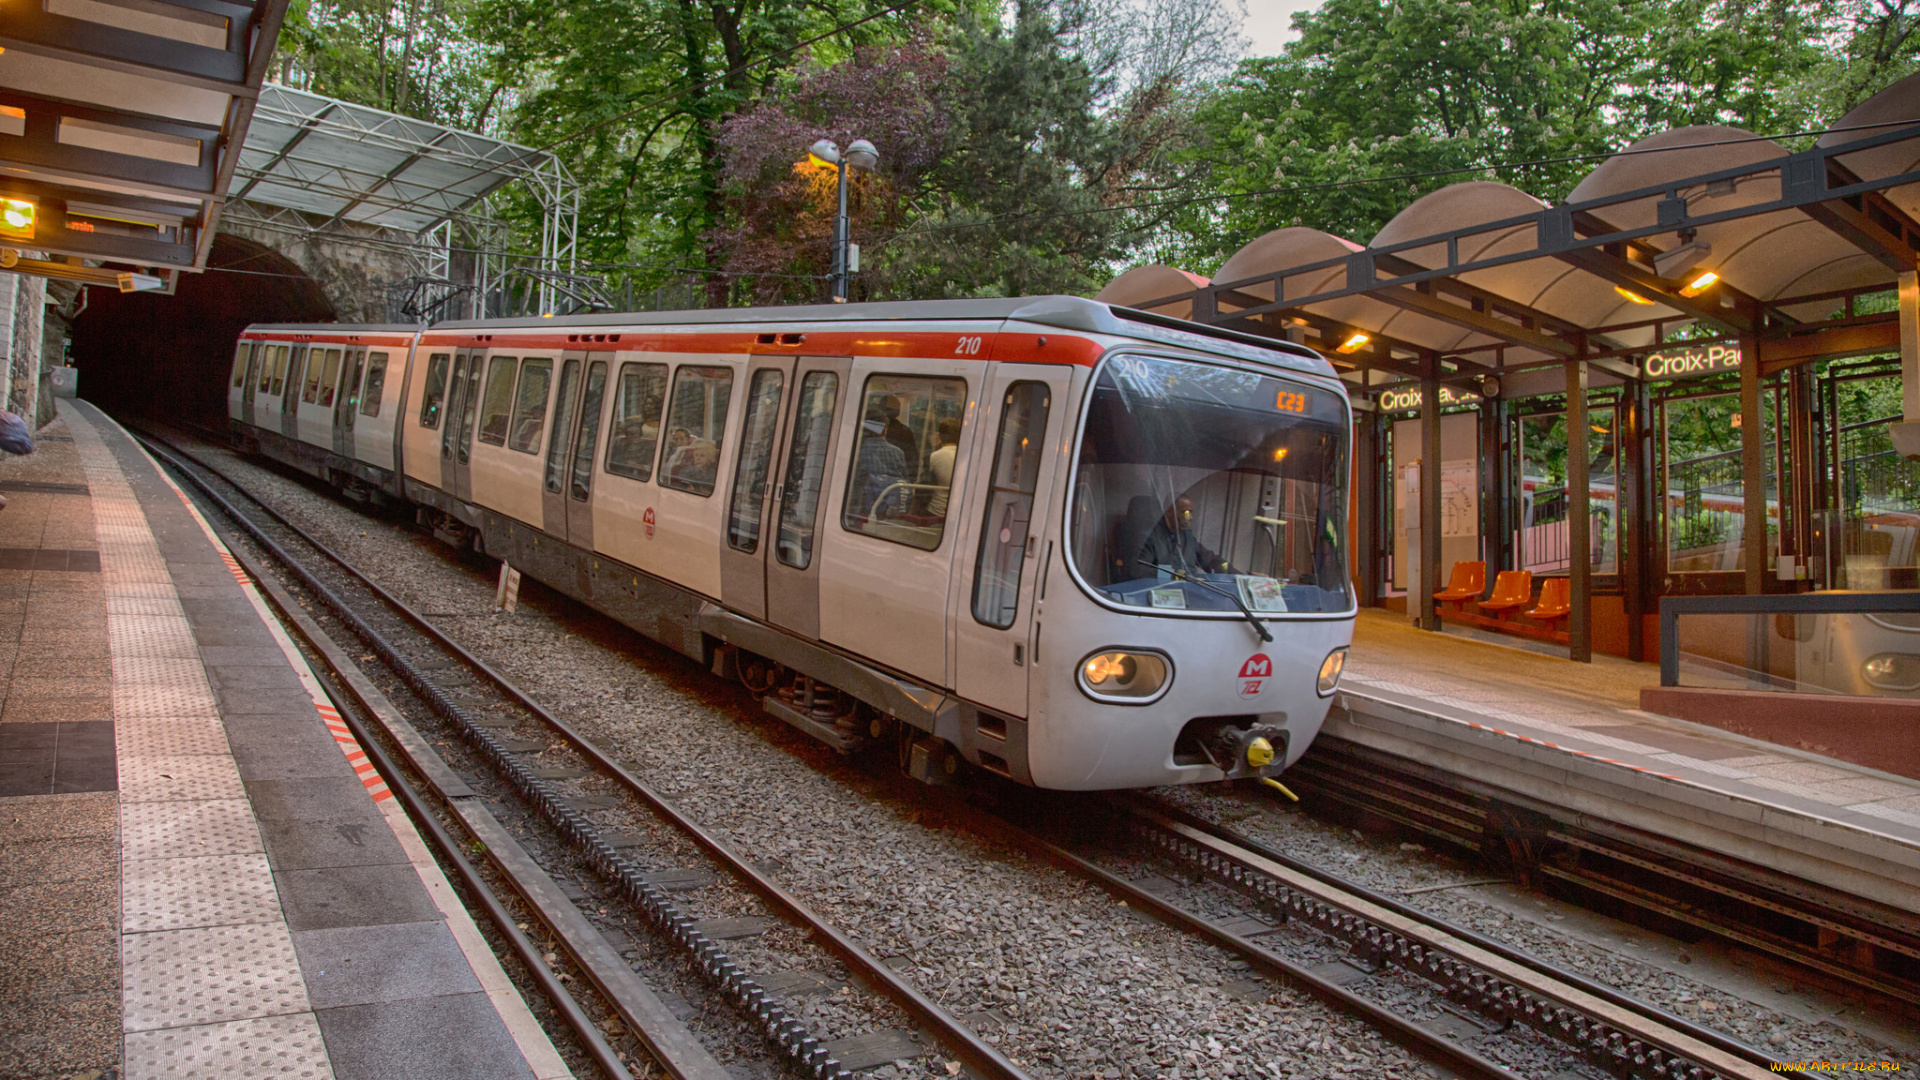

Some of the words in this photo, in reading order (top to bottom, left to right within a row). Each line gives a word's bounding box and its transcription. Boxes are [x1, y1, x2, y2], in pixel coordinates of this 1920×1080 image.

[954, 336, 982, 355] 210
[1276, 391, 1305, 413] C23
[1245, 660, 1269, 675] M
